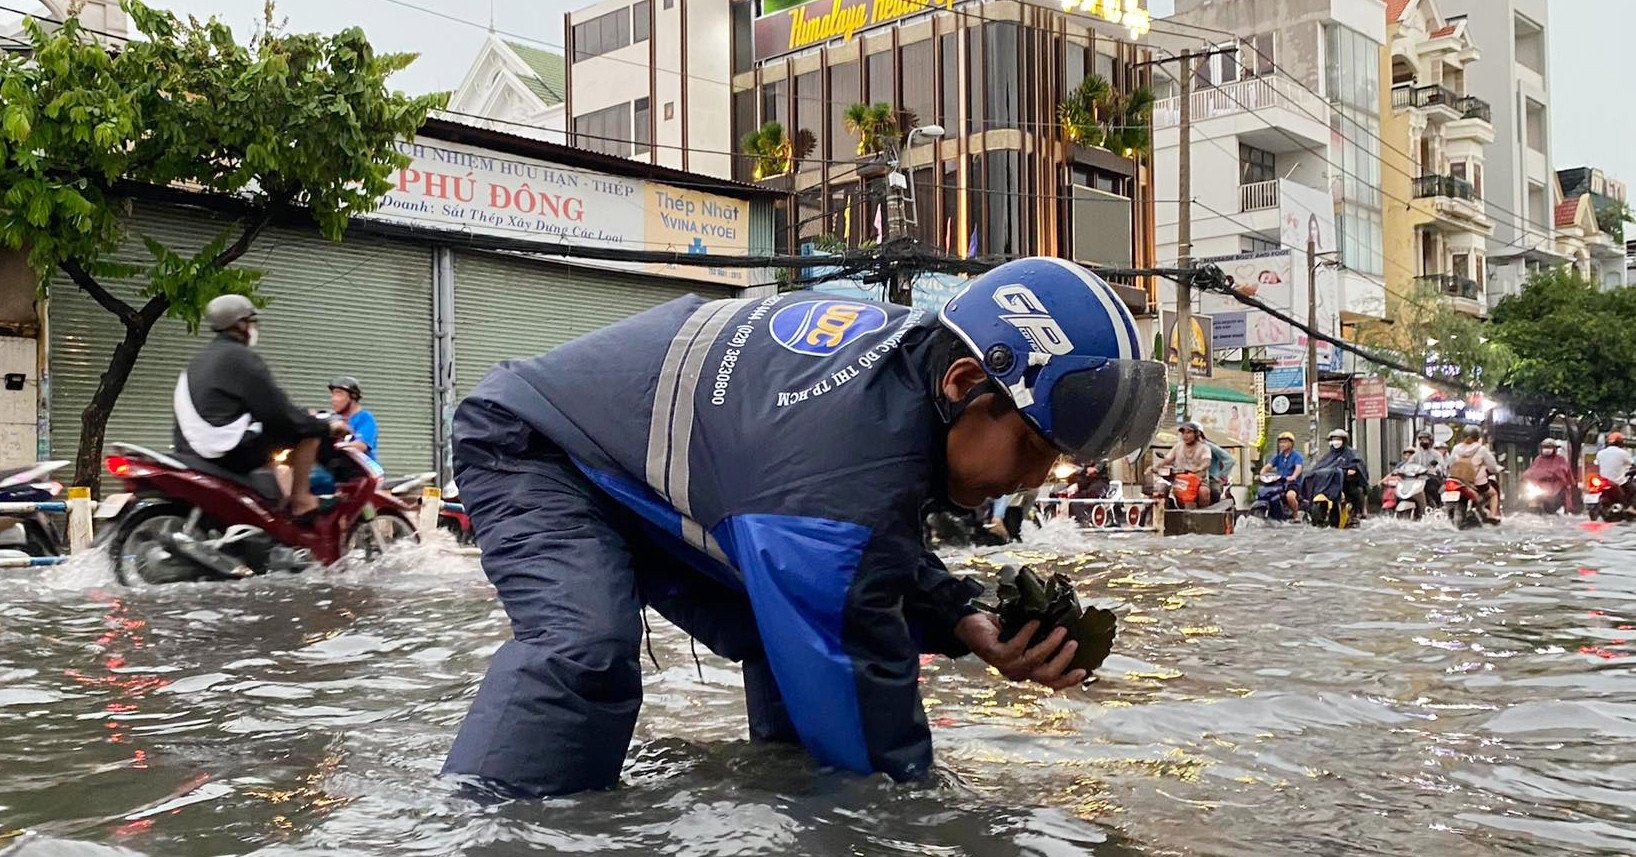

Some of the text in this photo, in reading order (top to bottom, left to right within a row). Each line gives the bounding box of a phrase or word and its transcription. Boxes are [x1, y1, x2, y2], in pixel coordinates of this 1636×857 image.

[789, 0, 867, 48] Himalaya
[396, 168, 476, 203] PHÚ
[433, 149, 494, 172] NHIỆM
[544, 170, 578, 188] HẠN
[592, 179, 634, 197] THÉP
[470, 208, 503, 227] Thép
[655, 191, 695, 216] Thép
[669, 216, 736, 240] VINA KYOEI
[806, 304, 866, 347] UDC
[711, 325, 755, 406] (028) 38230800
[831, 366, 860, 387] THỊ
[777, 379, 832, 407] TP.HCM
